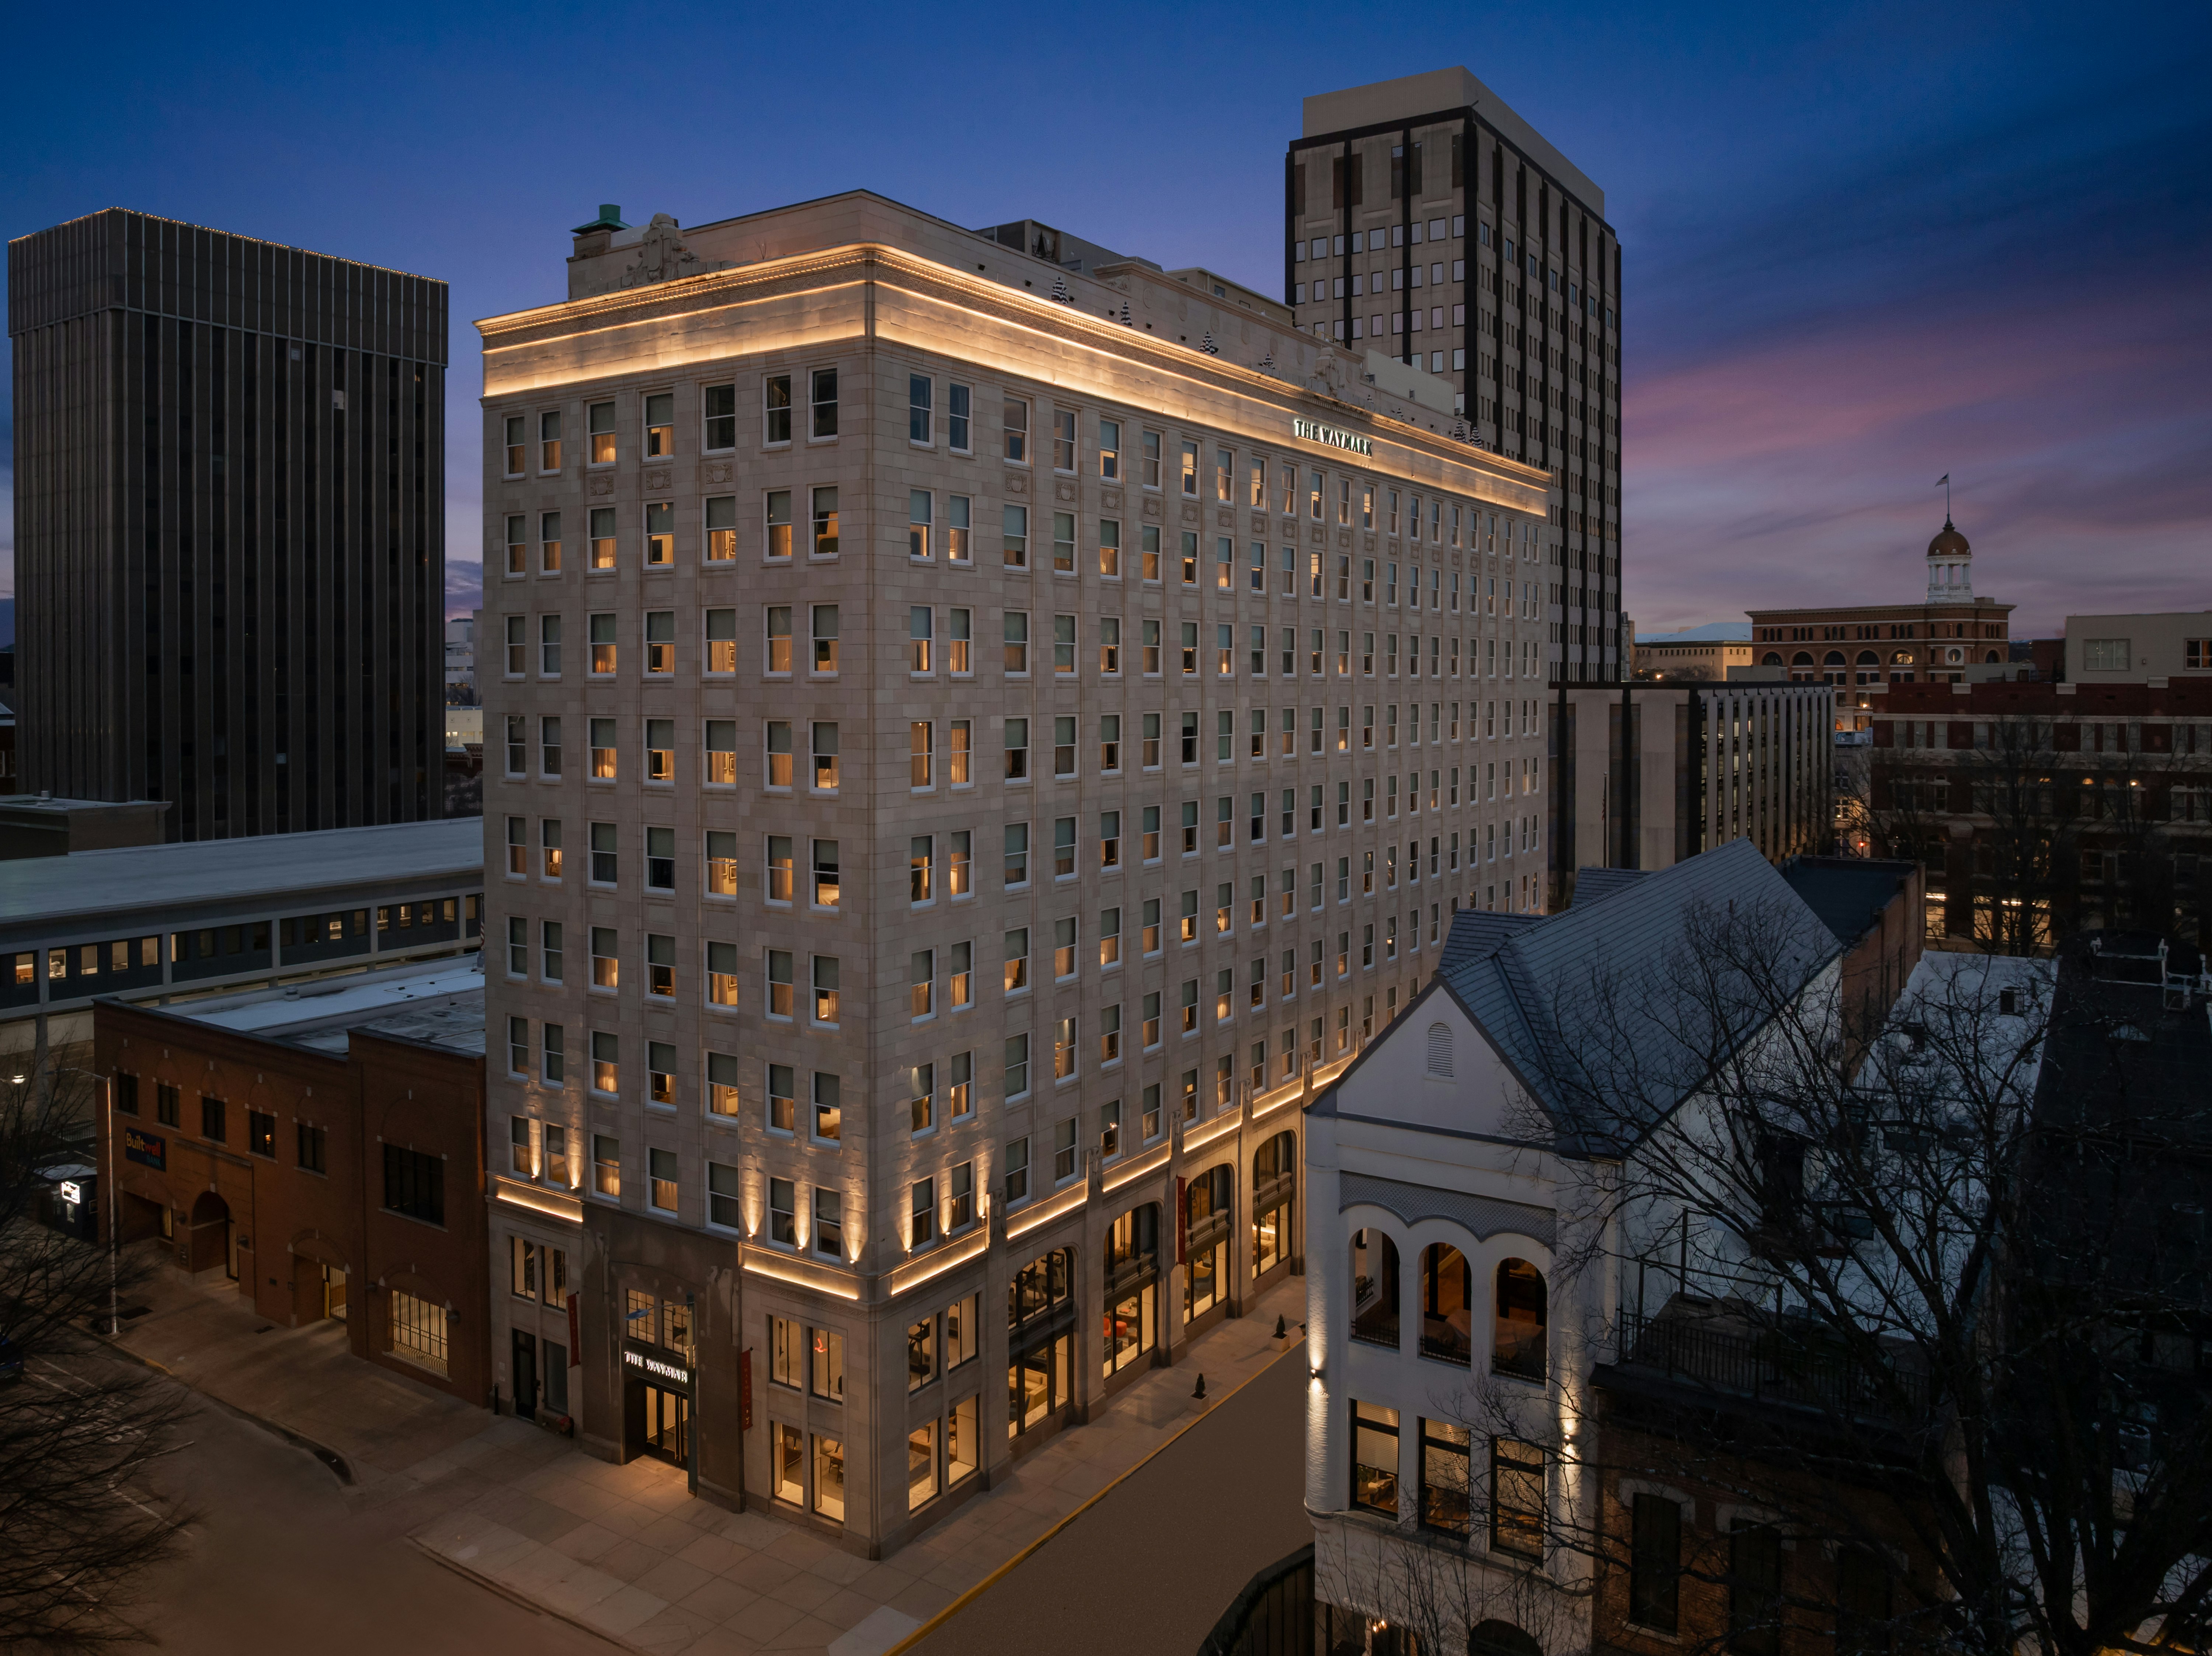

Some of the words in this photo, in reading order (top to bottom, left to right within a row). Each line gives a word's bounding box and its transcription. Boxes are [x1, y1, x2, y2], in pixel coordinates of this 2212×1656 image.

[1296, 421, 1318, 441] THE
[1322, 428, 1372, 456] WAYMARK
[126, 1132, 161, 1157] Builtwell
[147, 1154, 161, 1167] BANK
[625, 1351, 643, 1367] THE
[646, 1359, 688, 1383] WAYMAR
